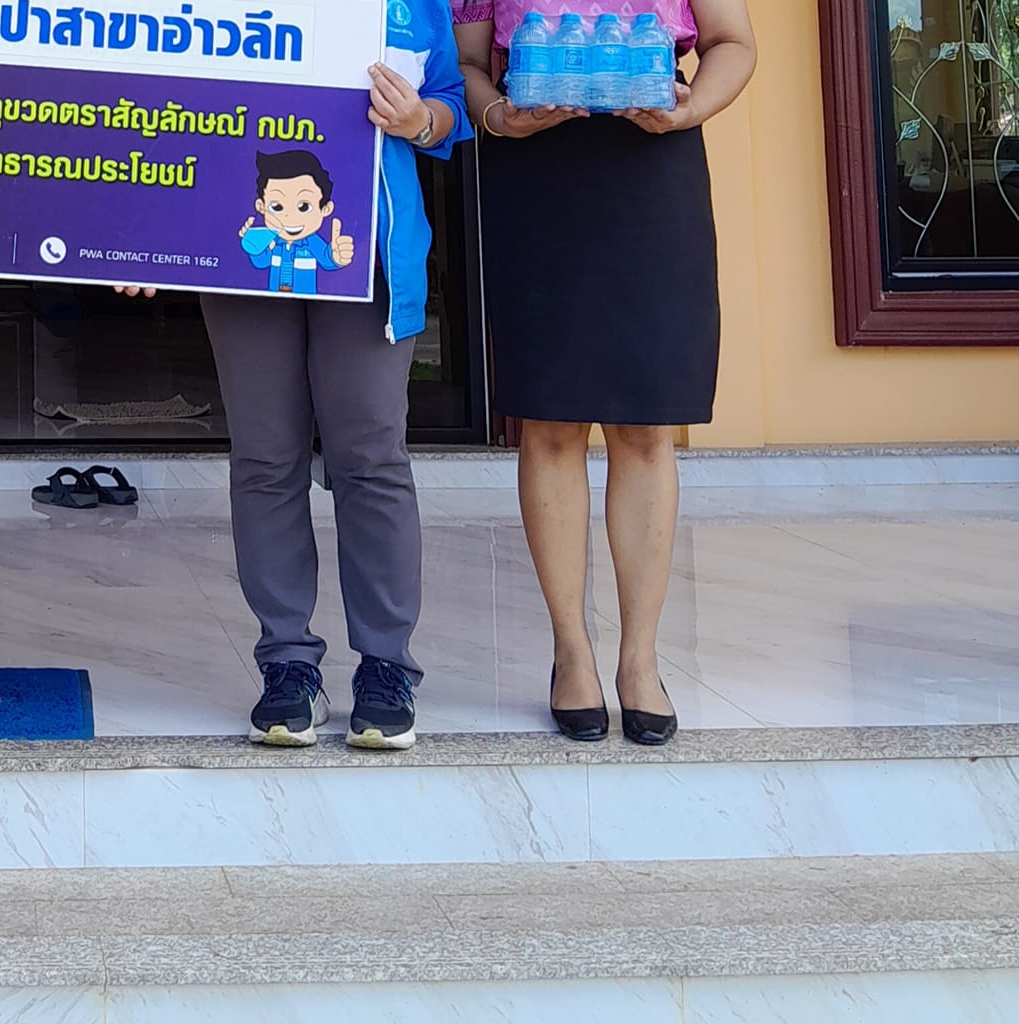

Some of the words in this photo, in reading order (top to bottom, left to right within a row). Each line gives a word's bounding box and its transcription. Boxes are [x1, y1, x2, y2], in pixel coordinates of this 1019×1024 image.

[257, 114, 325, 143] กปภ.
[79, 248, 104, 260] PWA
[105, 250, 150, 263] CONTACT
[151, 253, 191, 266] CENTER
[194, 256, 220, 268] 1662
